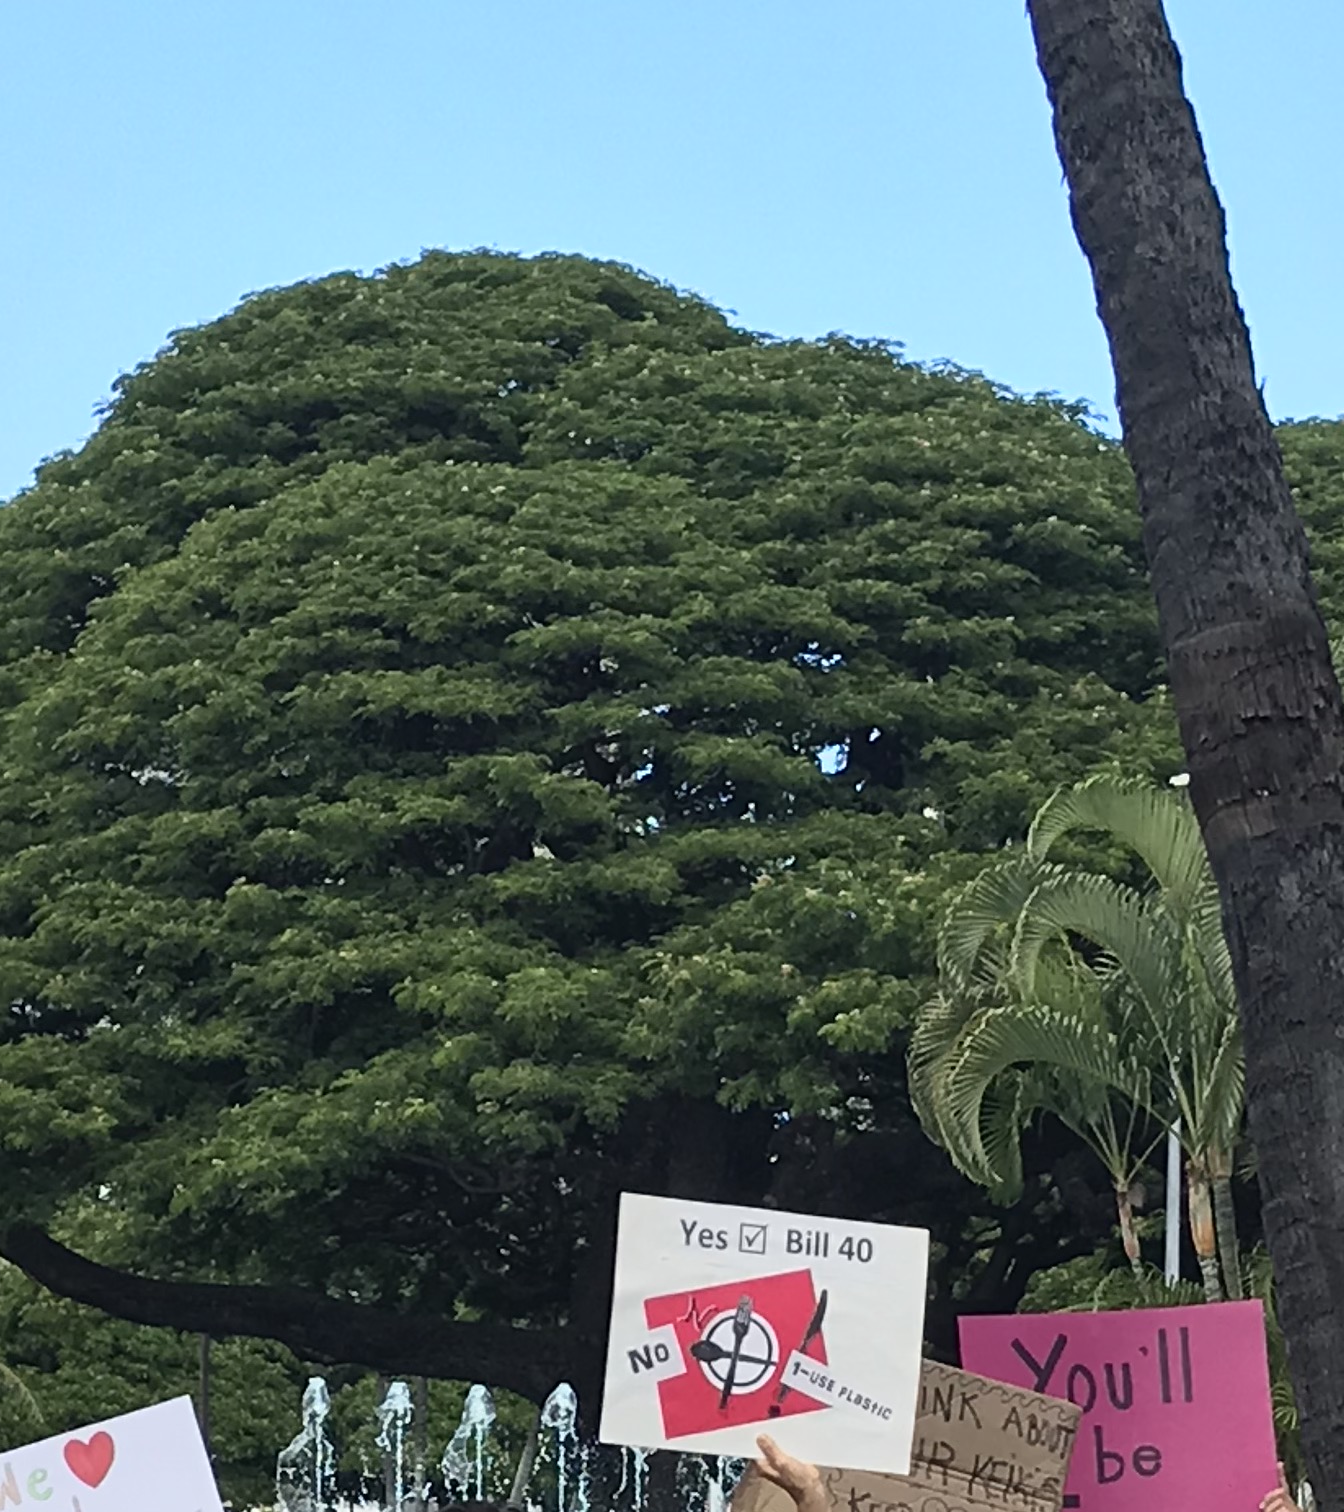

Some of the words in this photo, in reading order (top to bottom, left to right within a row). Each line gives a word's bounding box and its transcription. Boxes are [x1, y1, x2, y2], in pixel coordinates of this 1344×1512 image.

[680, 1218, 729, 1250] Yes
[786, 1228, 830, 1257] Bill
[838, 1237, 873, 1263] 40
[627, 1342, 670, 1374] No
[792, 1361, 835, 1393] 1-USE
[1011, 1327, 1193, 1414] You'll
[921, 1383, 982, 1429] INK
[1094, 1425, 1163, 1484] be
